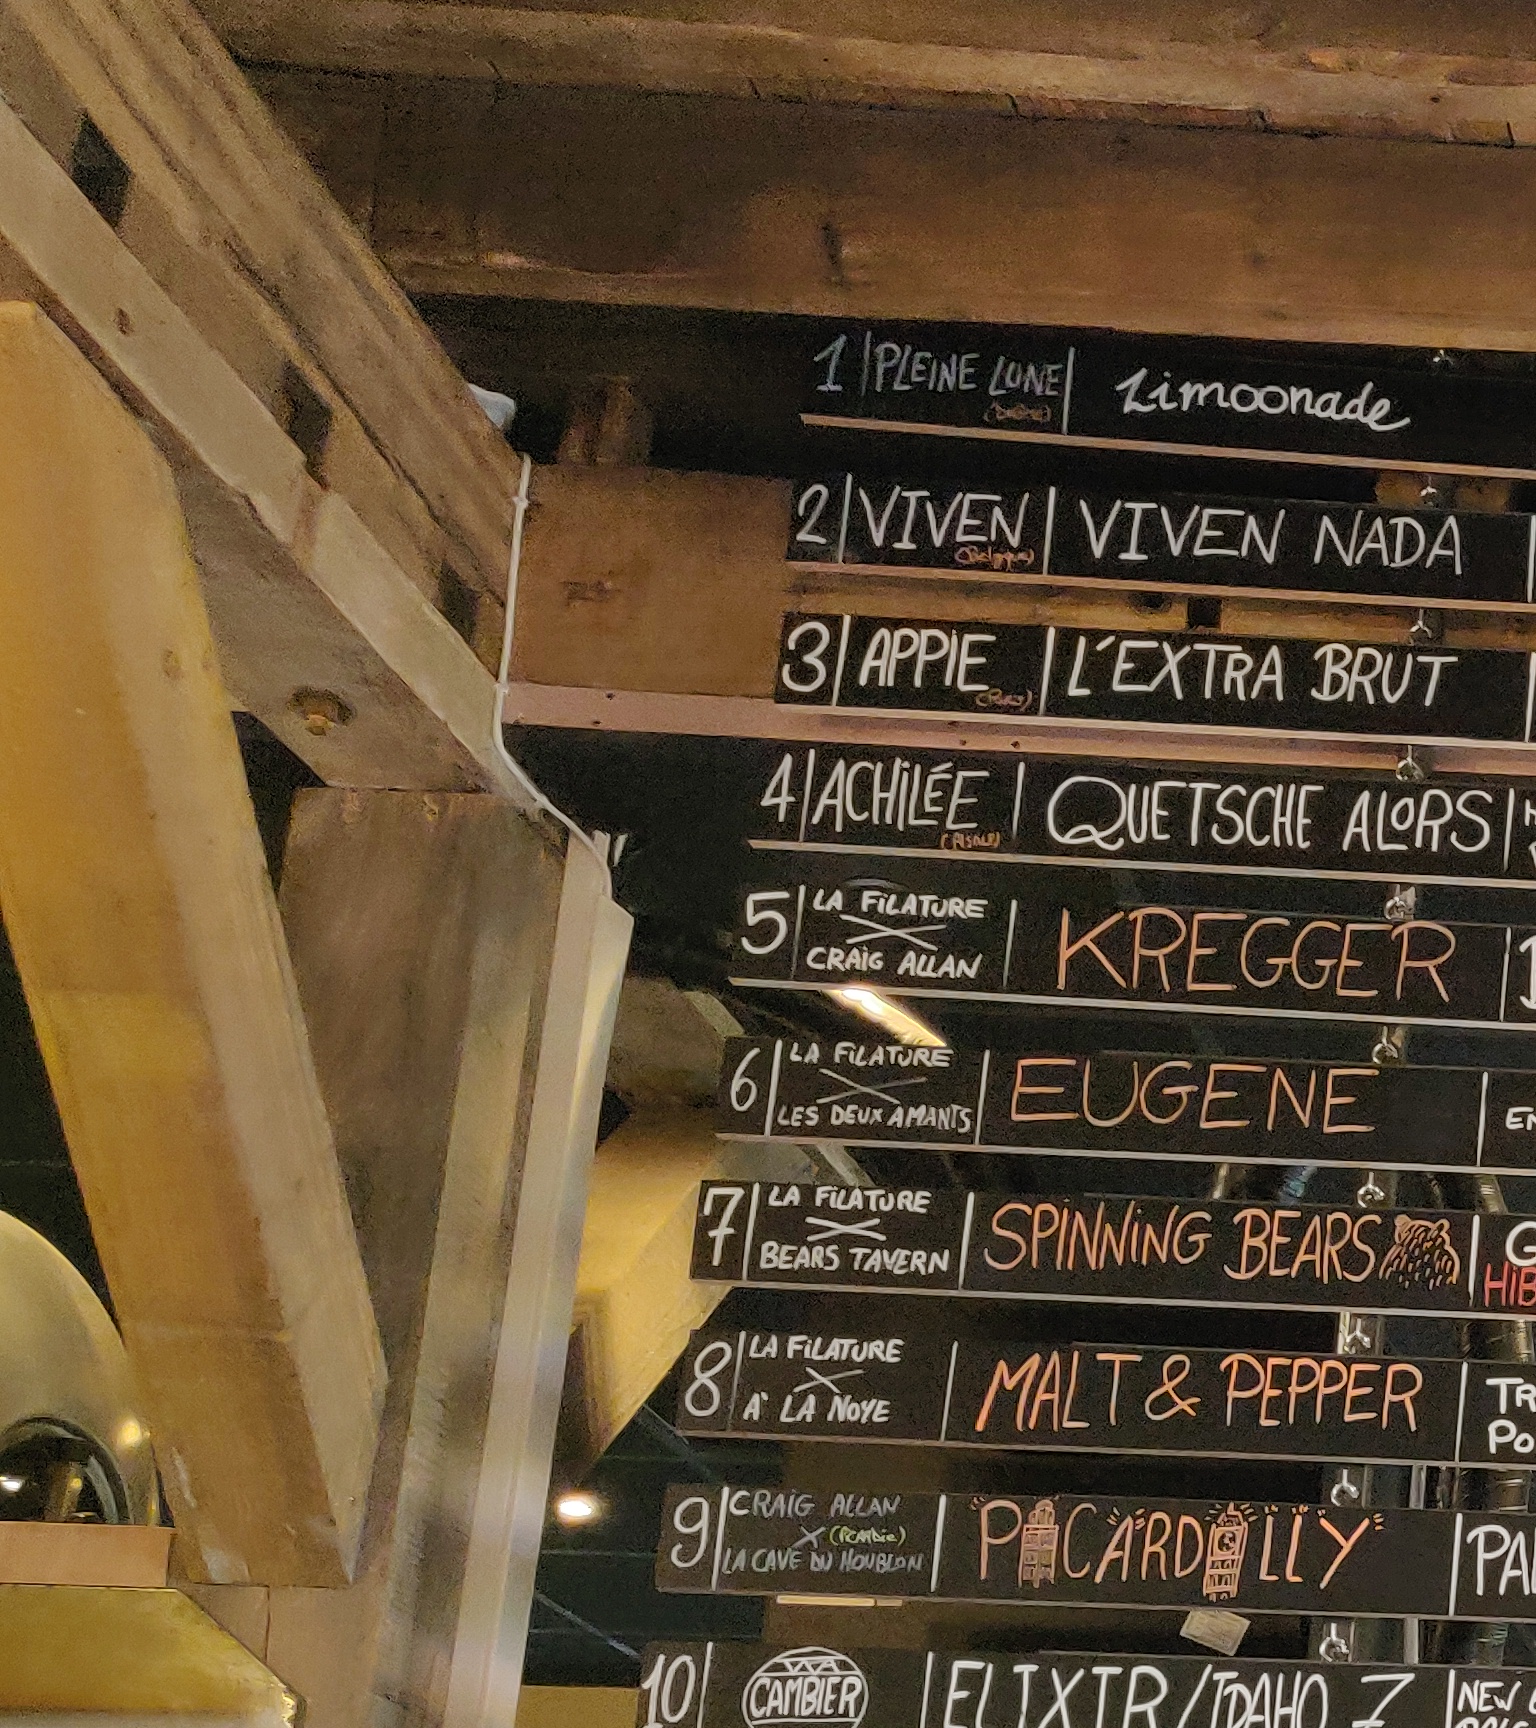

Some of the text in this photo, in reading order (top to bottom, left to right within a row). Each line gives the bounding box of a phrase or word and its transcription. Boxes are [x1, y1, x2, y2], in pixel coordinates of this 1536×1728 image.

[814, 333, 847, 392] 1
[989, 355, 1063, 397] LUNE
[795, 484, 829, 545] 2
[858, 486, 1030, 551] VIVEN
[1079, 499, 1286, 564] VIVEN
[1313, 509, 1462, 575] NADA
[781, 621, 830, 693] 3
[1310, 642, 1459, 707] BRUT
[760, 752, 796, 823] 4
[1047, 775, 1325, 851] QUETSCHE
[741, 891, 791, 955] 5
[812, 888, 843, 912] LA
[897, 950, 983, 979] ALLAN
[1054, 904, 1456, 1005] KREGGER
[730, 1053, 758, 1112] 6
[789, 1042, 820, 1064] LA
[777, 1105, 820, 1127] LES
[886, 1101, 972, 1133] AMANTS
[1010, 1055, 1381, 1134] EUGENE
[768, 1185, 801, 1207] LA
[703, 1186, 747, 1269] 7
[759, 1237, 950, 1276] BEARS TAVERN
[1223, 1207, 1384, 1285] BEARS
[748, 1334, 778, 1359] LA
[681, 1340, 733, 1417] 8
[779, 1393, 816, 1423] LA
[826, 1394, 891, 1424] NOYE
[974, 1349, 1423, 1432] MALT & PEPPER
[670, 1496, 710, 1568] 9
[746, 1671, 865, 1722] CAMBIER
[1457, 1679, 1522, 1713] NEW
